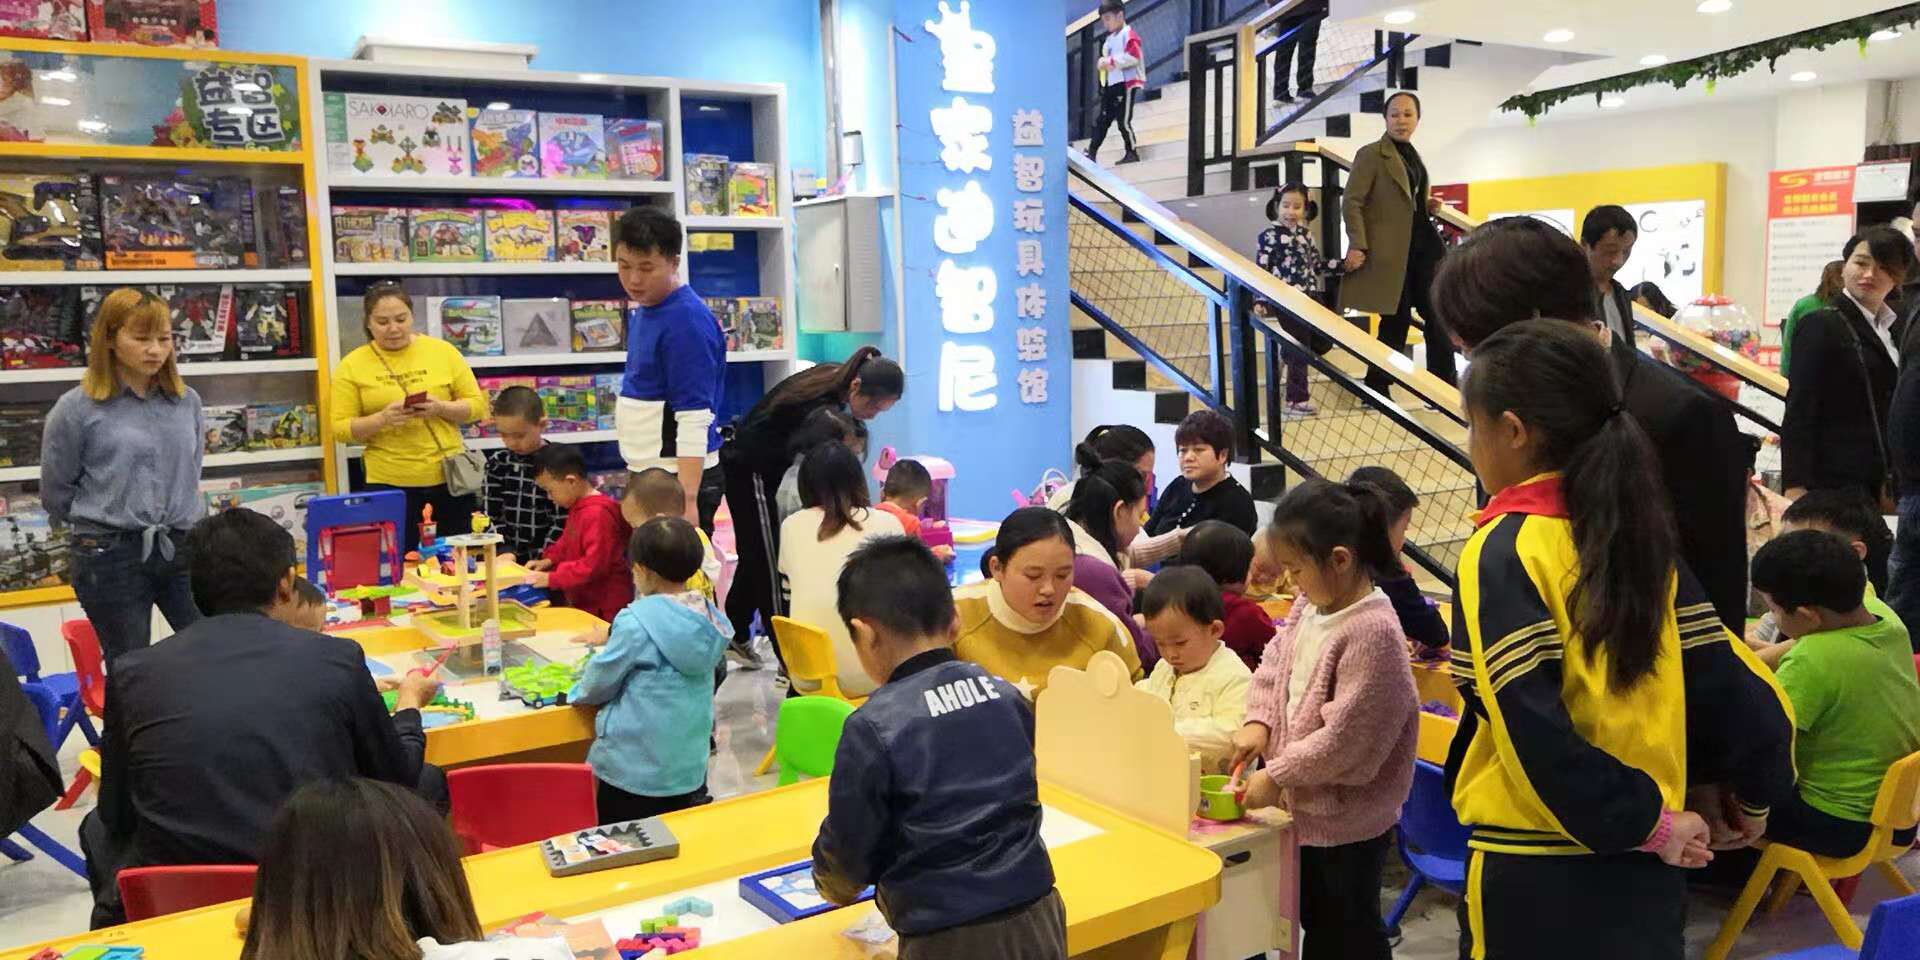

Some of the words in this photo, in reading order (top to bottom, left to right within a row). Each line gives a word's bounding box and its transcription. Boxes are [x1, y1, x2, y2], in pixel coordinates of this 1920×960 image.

[195, 70, 273, 106] 益智
[205, 108, 283, 141] 专区
[1012, 108, 1049, 405] 益智玩具体验馆
[924, 675, 1001, 717] AHOLE
